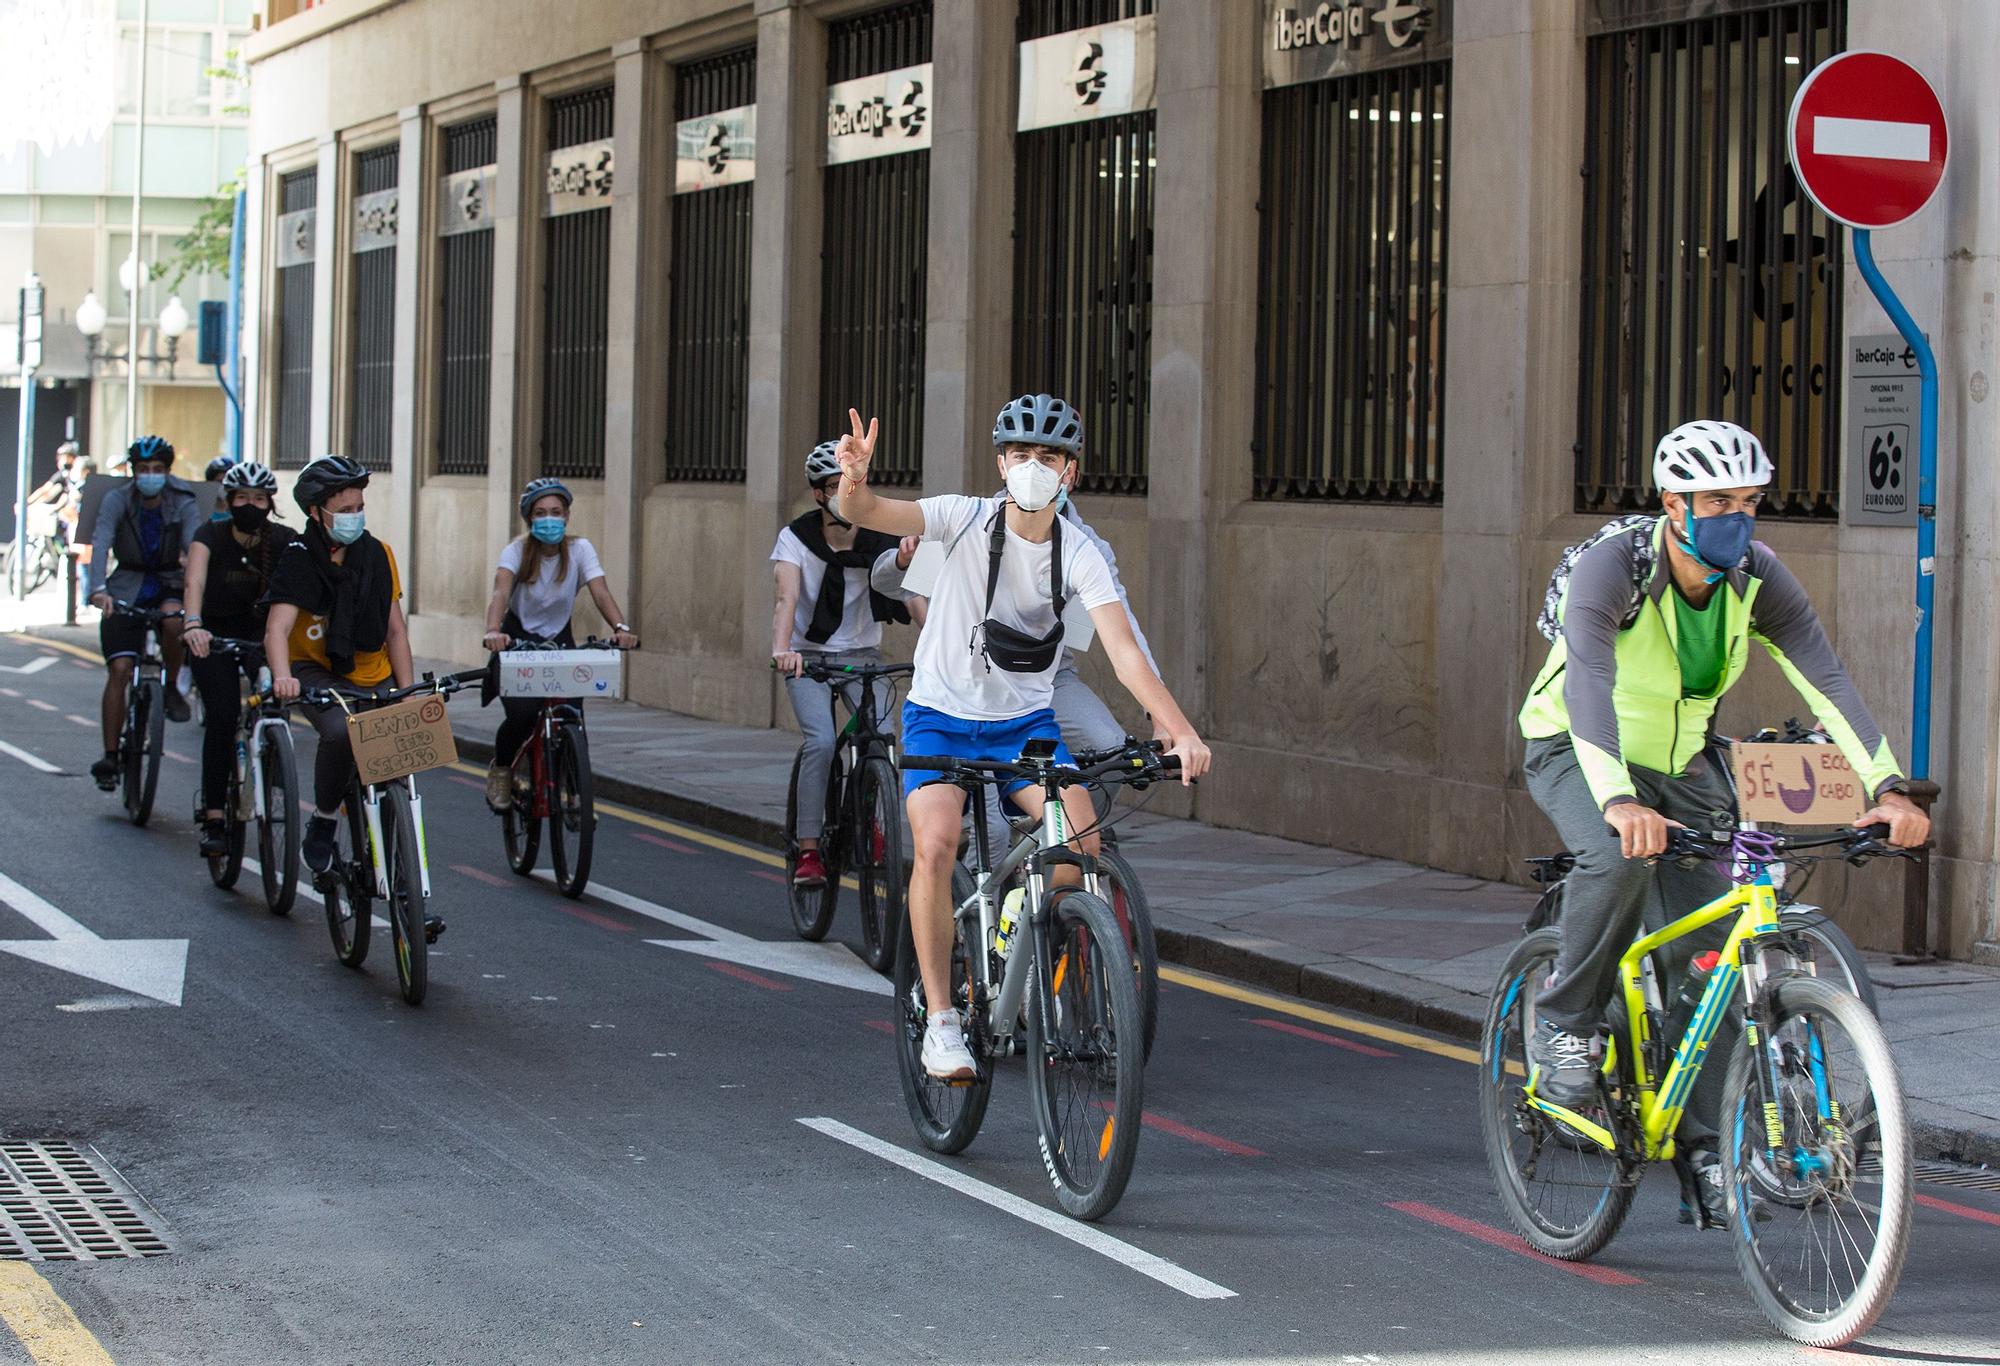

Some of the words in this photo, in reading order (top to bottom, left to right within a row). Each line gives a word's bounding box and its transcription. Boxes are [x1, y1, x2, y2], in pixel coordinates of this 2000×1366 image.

[1274, 1, 1363, 50] iberCaja
[1855, 347, 1895, 366] iberCaja
[1865, 494, 1884, 505] EURO
[1885, 494, 1904, 506] 6000
[517, 667, 534, 679] NO
[542, 666, 555, 678] ES
[517, 681, 532, 692] LA
[425, 705, 440, 718] 30
[1744, 753, 1776, 801] SÉ
[1820, 783, 1855, 800] CABO
[1038, 1134, 1062, 1189] MAXXIS
